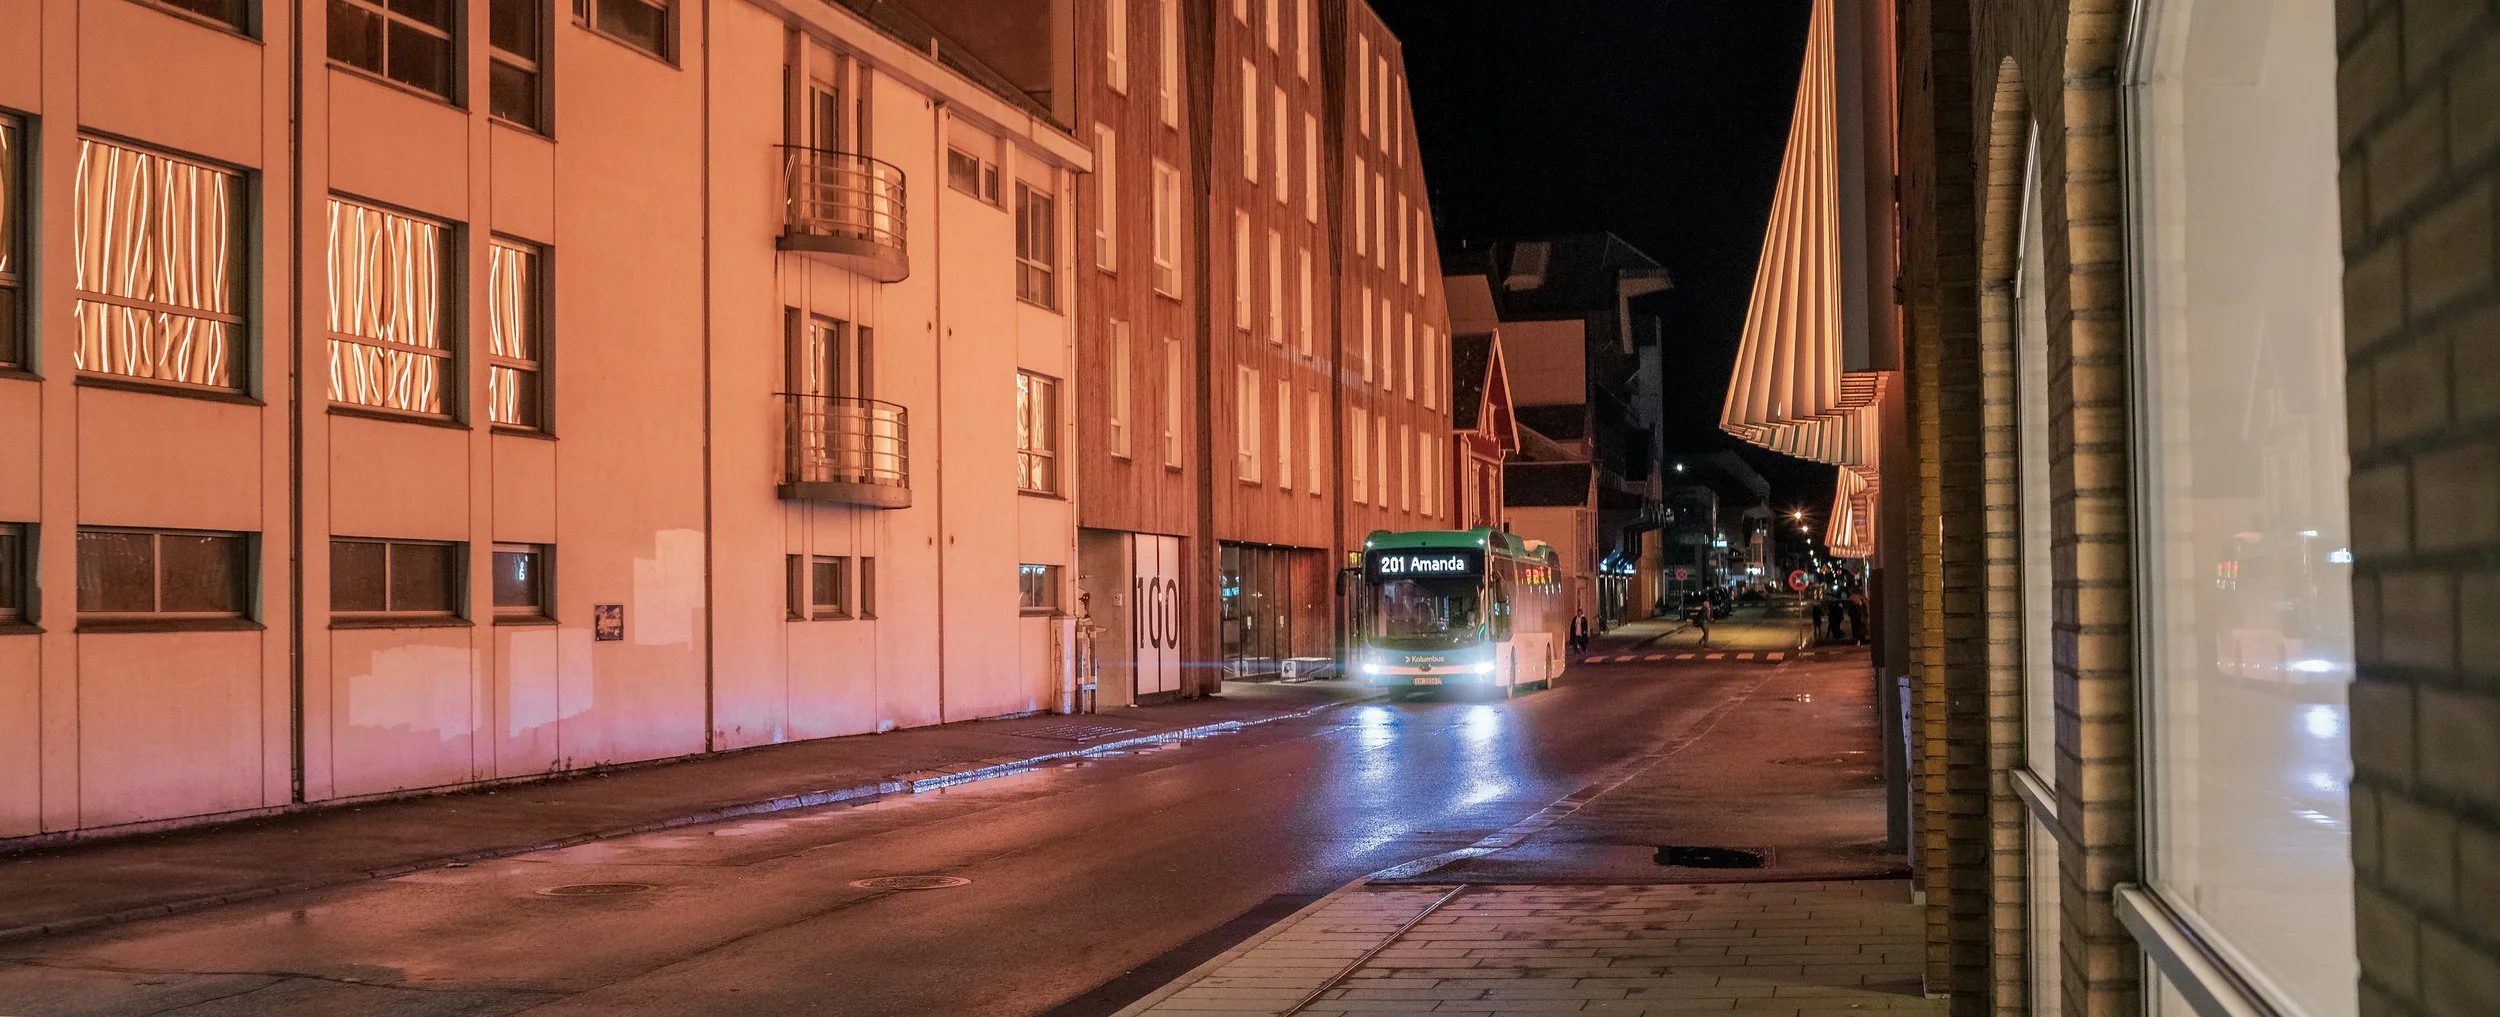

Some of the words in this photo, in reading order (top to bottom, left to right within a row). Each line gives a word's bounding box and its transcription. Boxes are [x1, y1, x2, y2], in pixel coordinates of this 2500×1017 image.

[1381, 556, 1405, 573] 201
[1411, 555, 1465, 572] Amanda
[1137, 577, 1179, 650] 100
